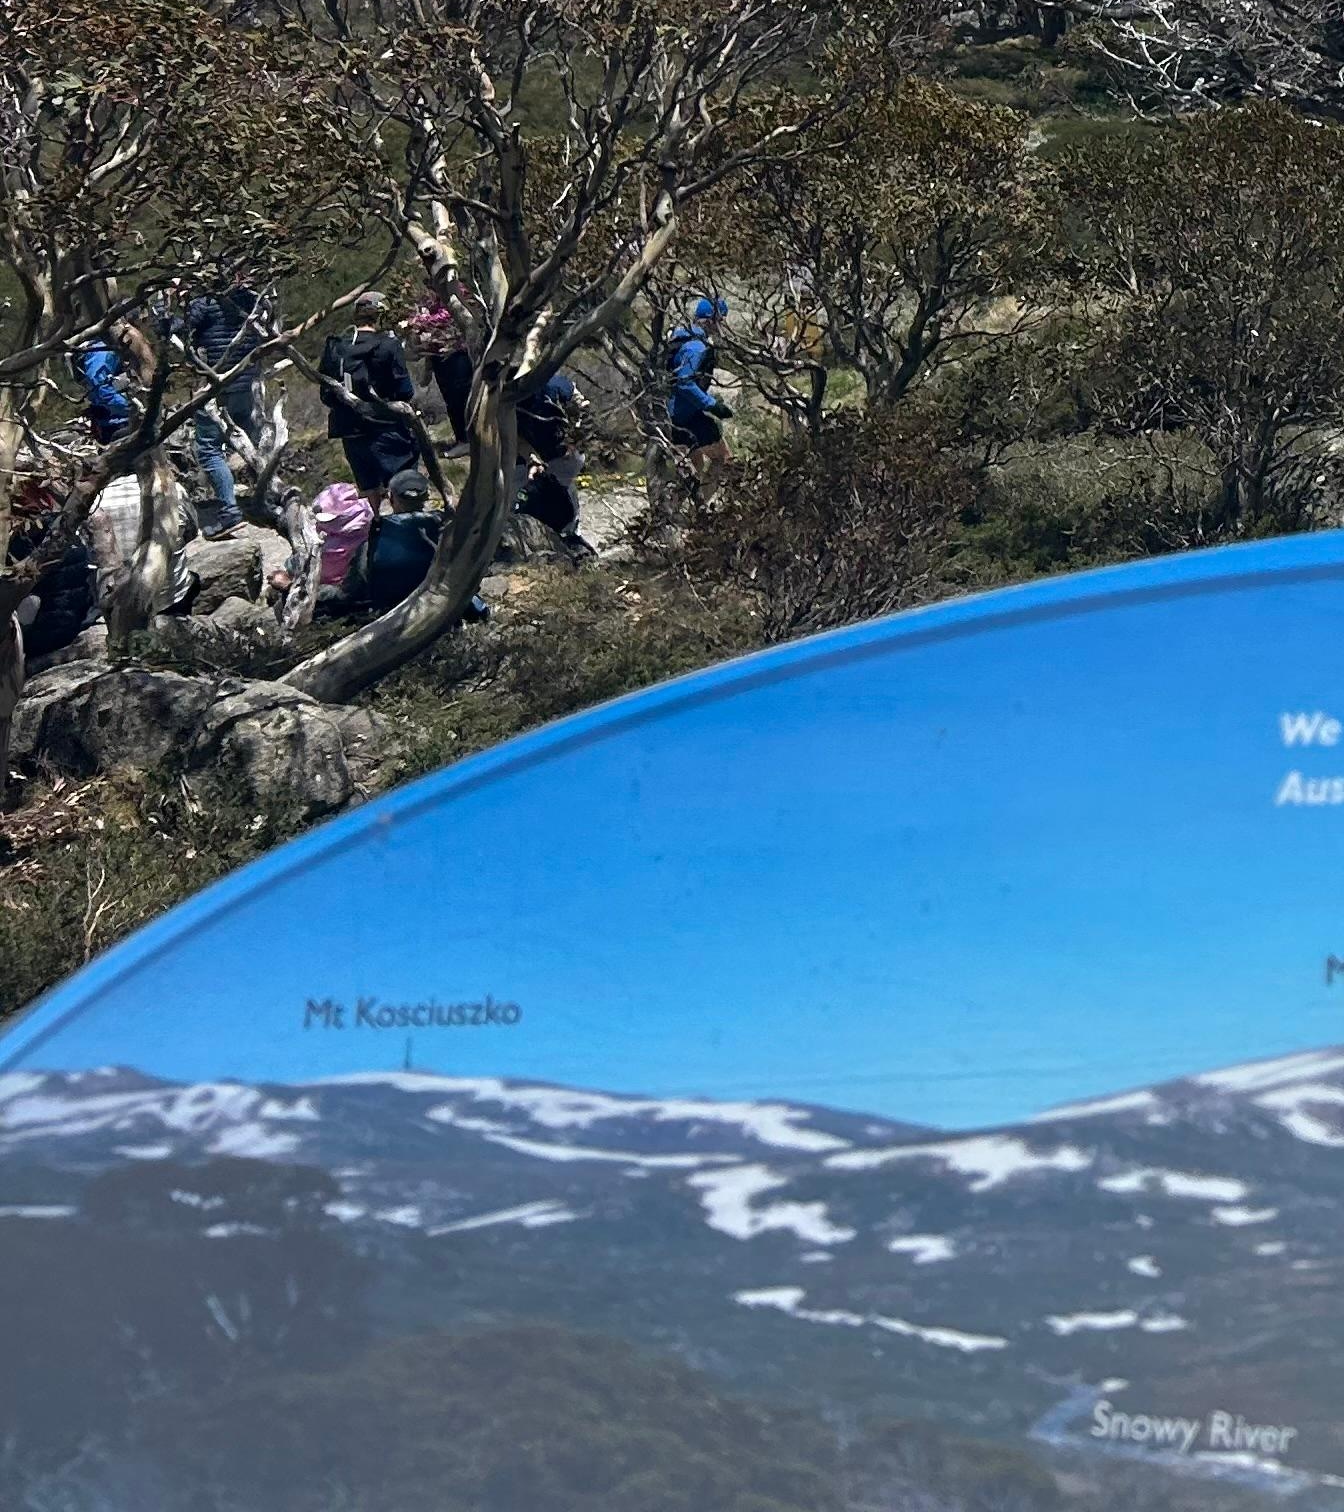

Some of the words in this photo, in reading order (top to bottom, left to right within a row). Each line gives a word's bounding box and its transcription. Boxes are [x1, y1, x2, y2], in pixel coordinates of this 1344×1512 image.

[1281, 711, 1342, 747] We
[303, 998, 345, 1029] Mt
[355, 993, 523, 1028] Kosciuszko
[1091, 1400, 1199, 1453] Snowy
[1210, 1409, 1297, 1453] River
